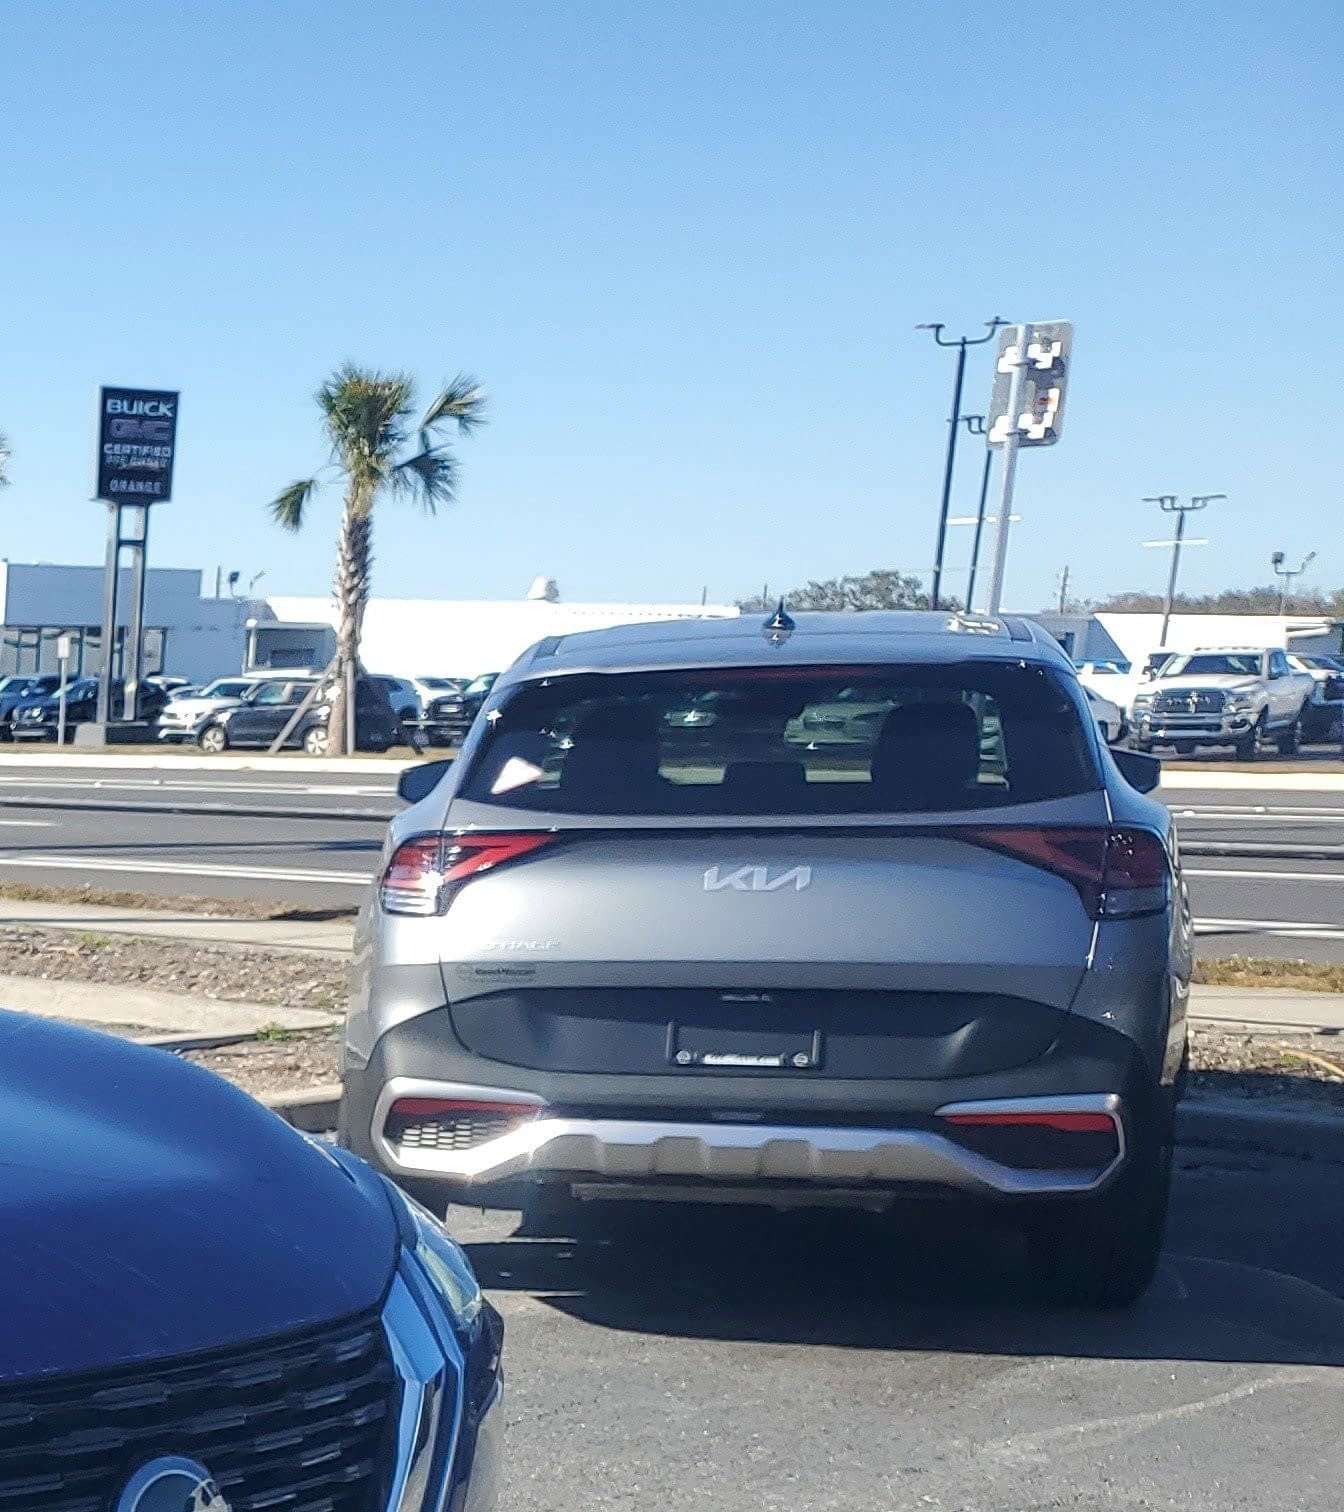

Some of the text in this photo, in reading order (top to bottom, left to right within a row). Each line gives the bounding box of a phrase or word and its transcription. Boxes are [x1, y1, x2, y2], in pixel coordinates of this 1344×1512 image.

[106, 399, 174, 417] BUICK
[104, 444, 172, 457] CERTIFIED
[109, 479, 162, 494] ORANGE
[703, 864, 813, 891] KIA
